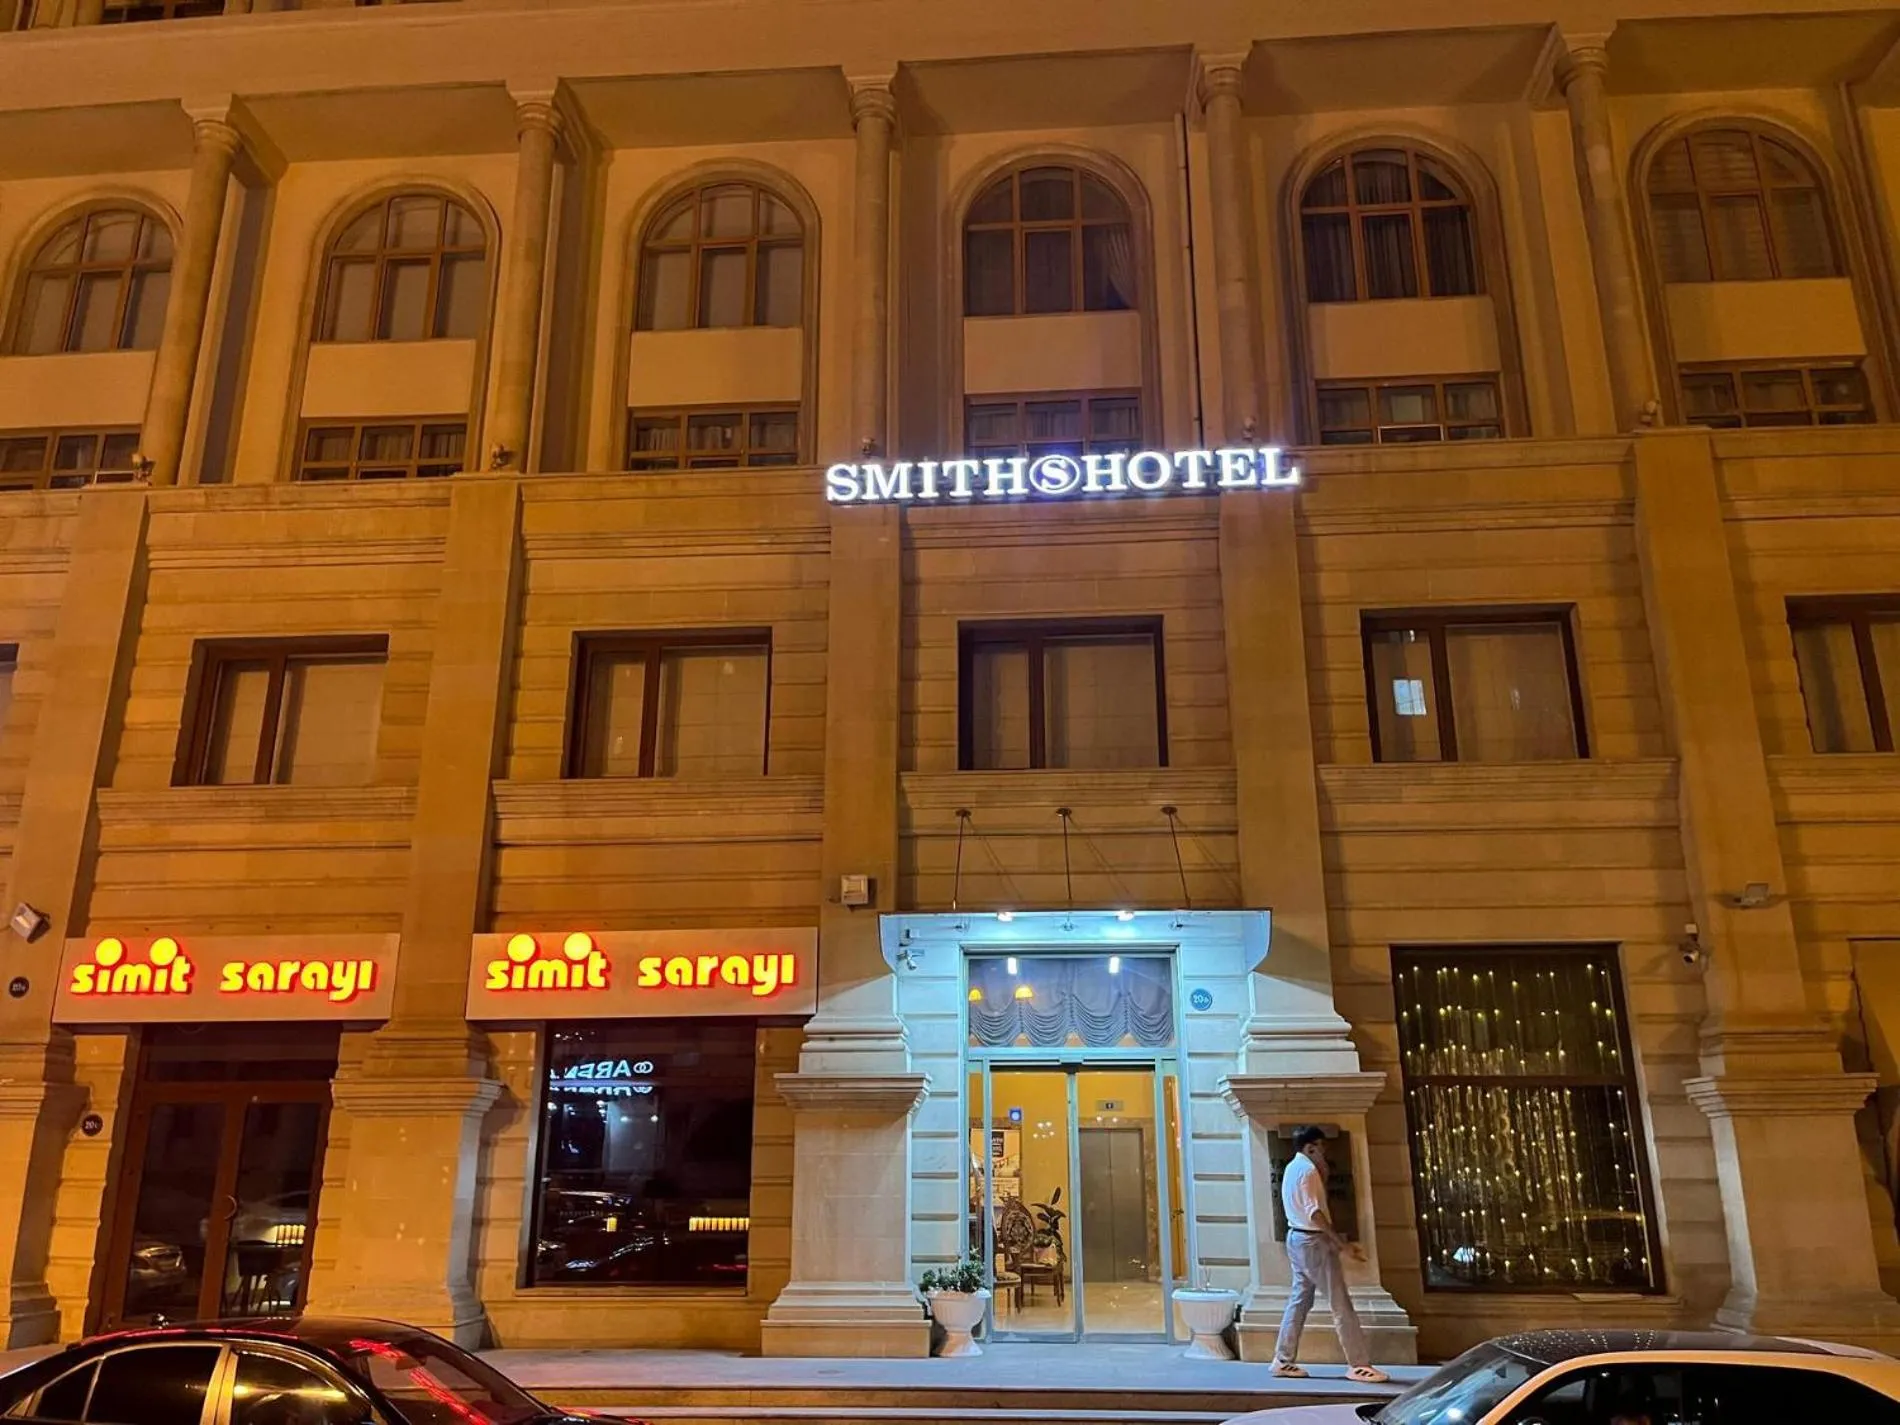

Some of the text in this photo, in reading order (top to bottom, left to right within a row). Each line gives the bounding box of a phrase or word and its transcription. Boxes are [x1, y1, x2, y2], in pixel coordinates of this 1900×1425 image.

[826, 457, 1027, 503] SMITH
[1081, 447, 1299, 493] HOTEL
[71, 937, 374, 1002] simit sarayı
[485, 931, 795, 997] simit sarayı
